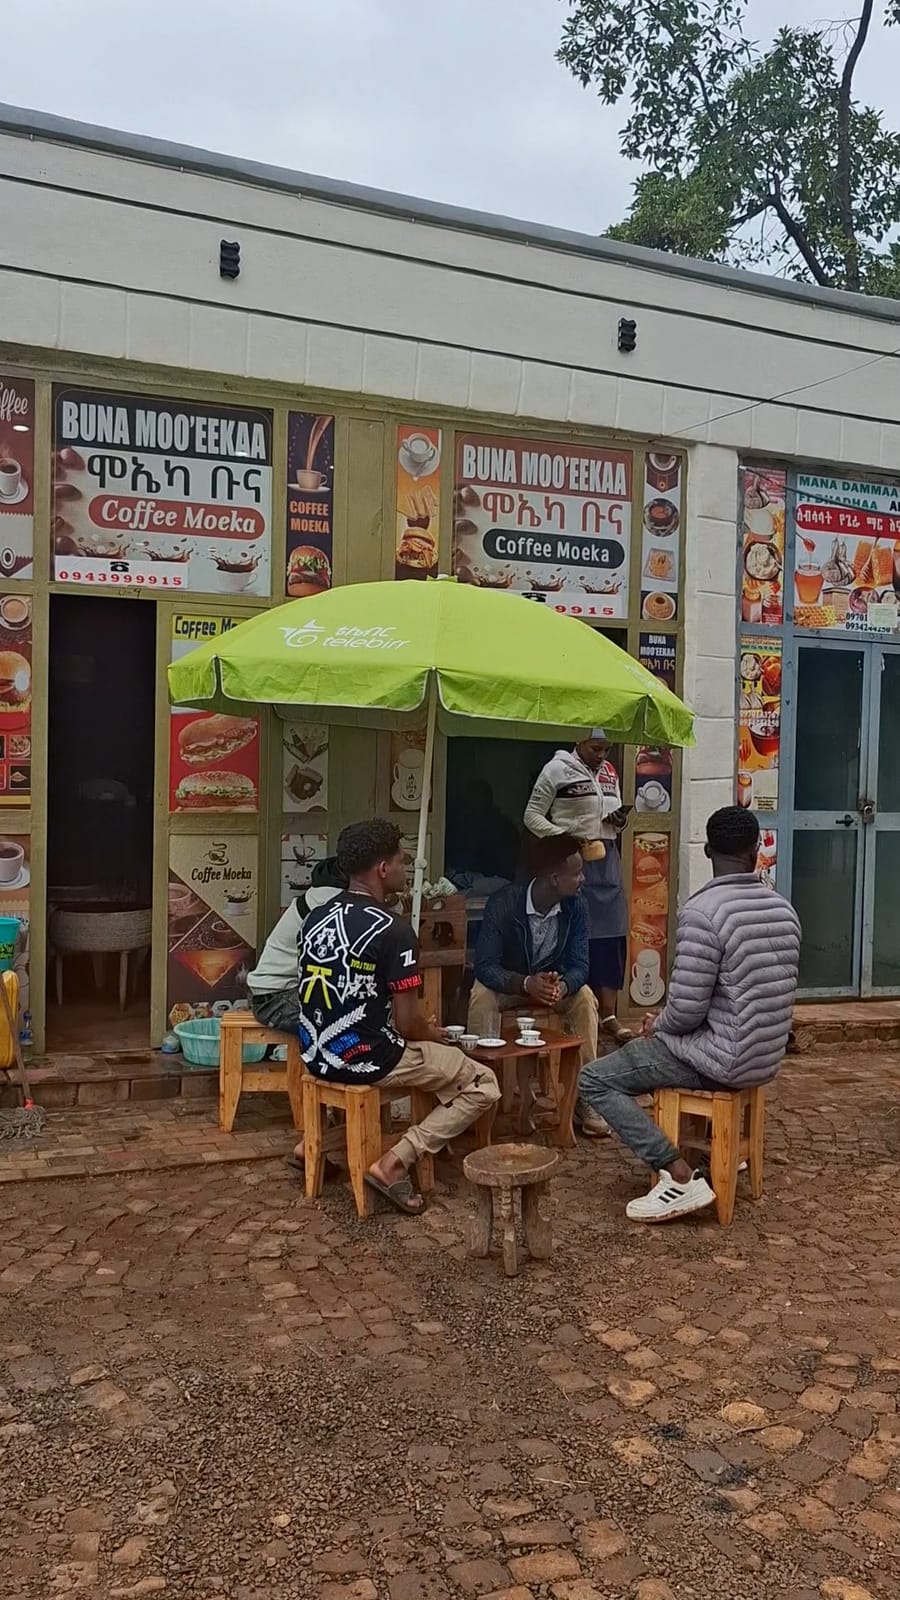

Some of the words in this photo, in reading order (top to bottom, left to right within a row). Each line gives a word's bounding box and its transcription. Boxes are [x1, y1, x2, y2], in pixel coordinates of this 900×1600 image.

[0, 382, 28, 422] ffee
[62, 400, 130, 446] BUNA
[136, 409, 266, 460] MOO'EEKAA
[463, 444, 517, 484] BUNA
[522, 451, 627, 496] MOO'EEKAA
[211, 465, 261, 503] ቡና
[799, 476, 838, 490] MANA
[841, 481, 899, 498] DAMMAA
[101, 500, 177, 530] Coffee
[182, 507, 256, 534] Moeka
[289, 500, 329, 517] COFFEE
[581, 501, 623, 535] ቡና
[290, 519, 329, 535] MOEKA
[495, 535, 552, 558] Coffee
[557, 541, 610, 563] Moeka
[59, 570, 183, 587] 0943999915
[175, 615, 217, 639] Coffee
[322, 637, 410, 649] telebirr
[649, 635, 666, 644] BUNA
[191, 866, 221, 884] Coffee
[222, 867, 252, 880] Moeka
